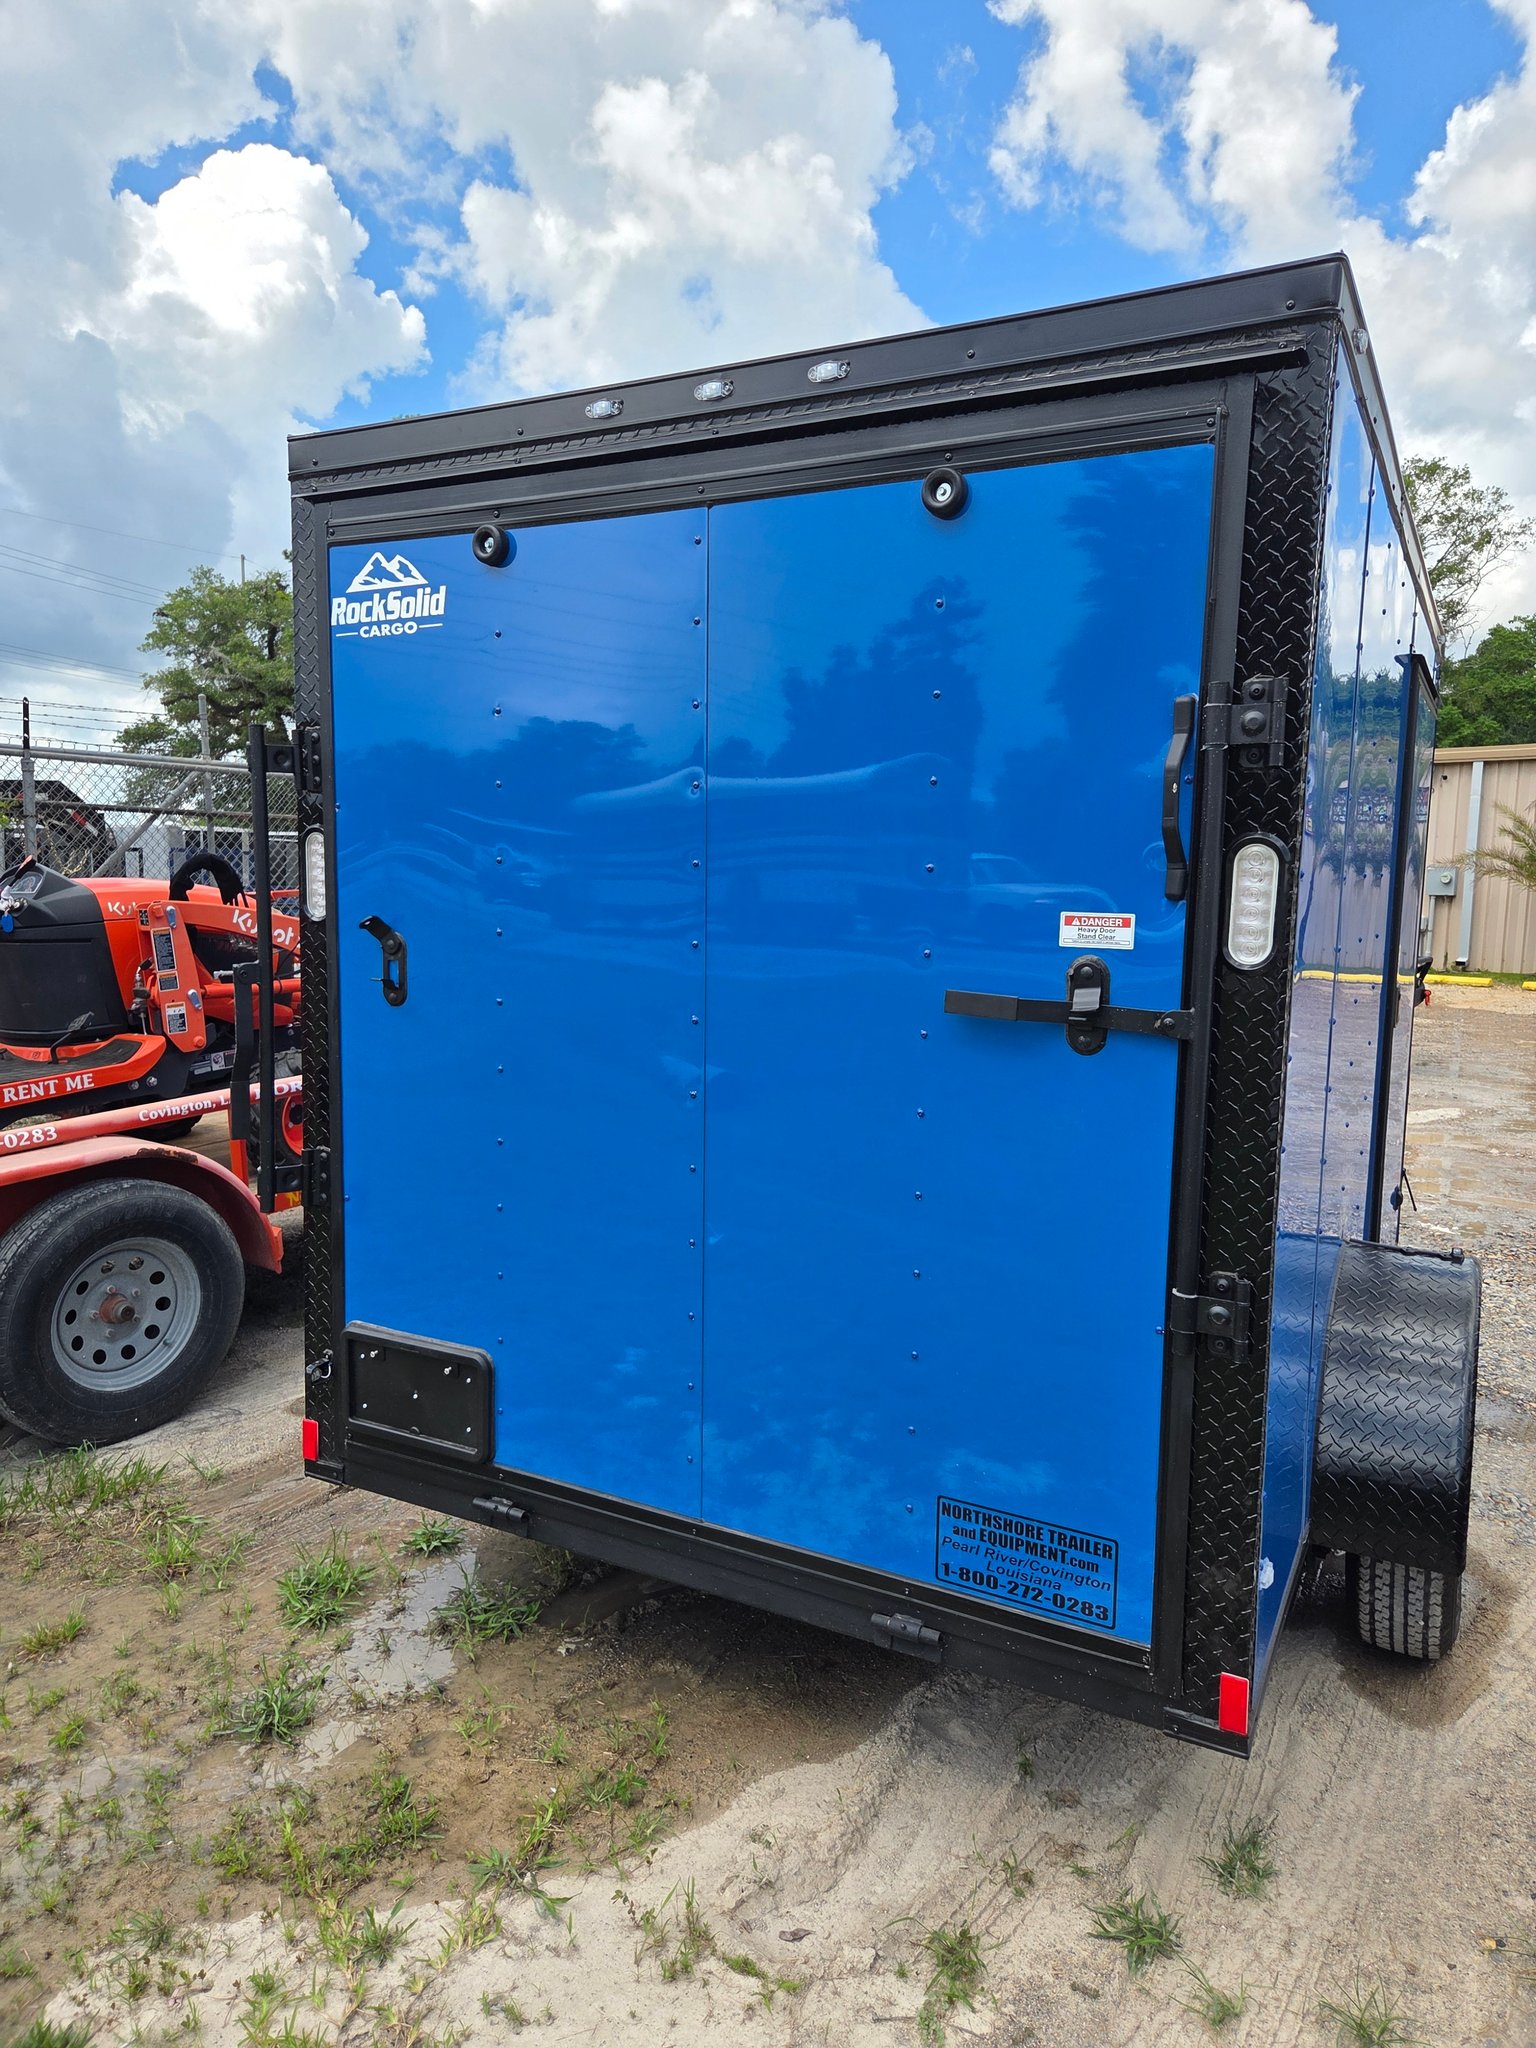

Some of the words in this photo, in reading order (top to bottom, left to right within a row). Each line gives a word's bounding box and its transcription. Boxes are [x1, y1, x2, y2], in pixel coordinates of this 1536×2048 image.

[331, 585, 447, 626] RockSolid
[359, 621, 418, 638] CARGO
[1081, 917, 1123, 926] DANGER
[3, 1079, 58, 1103] RENT
[65, 1073, 95, 1091] ME
[138, 1099, 216, 1122] Covington,
[220, 1095, 231, 1106] L
[941, 1502, 1044, 1542] NORTHSHORE
[1047, 1528, 1113, 1560] TRAILER
[941, 1536, 980, 1555] Pearl
[984, 1546, 1111, 1591] River/Covington
[952, 1525, 976, 1540] and
[979, 1529, 1099, 1573] EQUIPMENT.com
[941, 1562, 1109, 1622] 1-800-272-0283
[986, 1561, 1062, 1590] Louisiana
